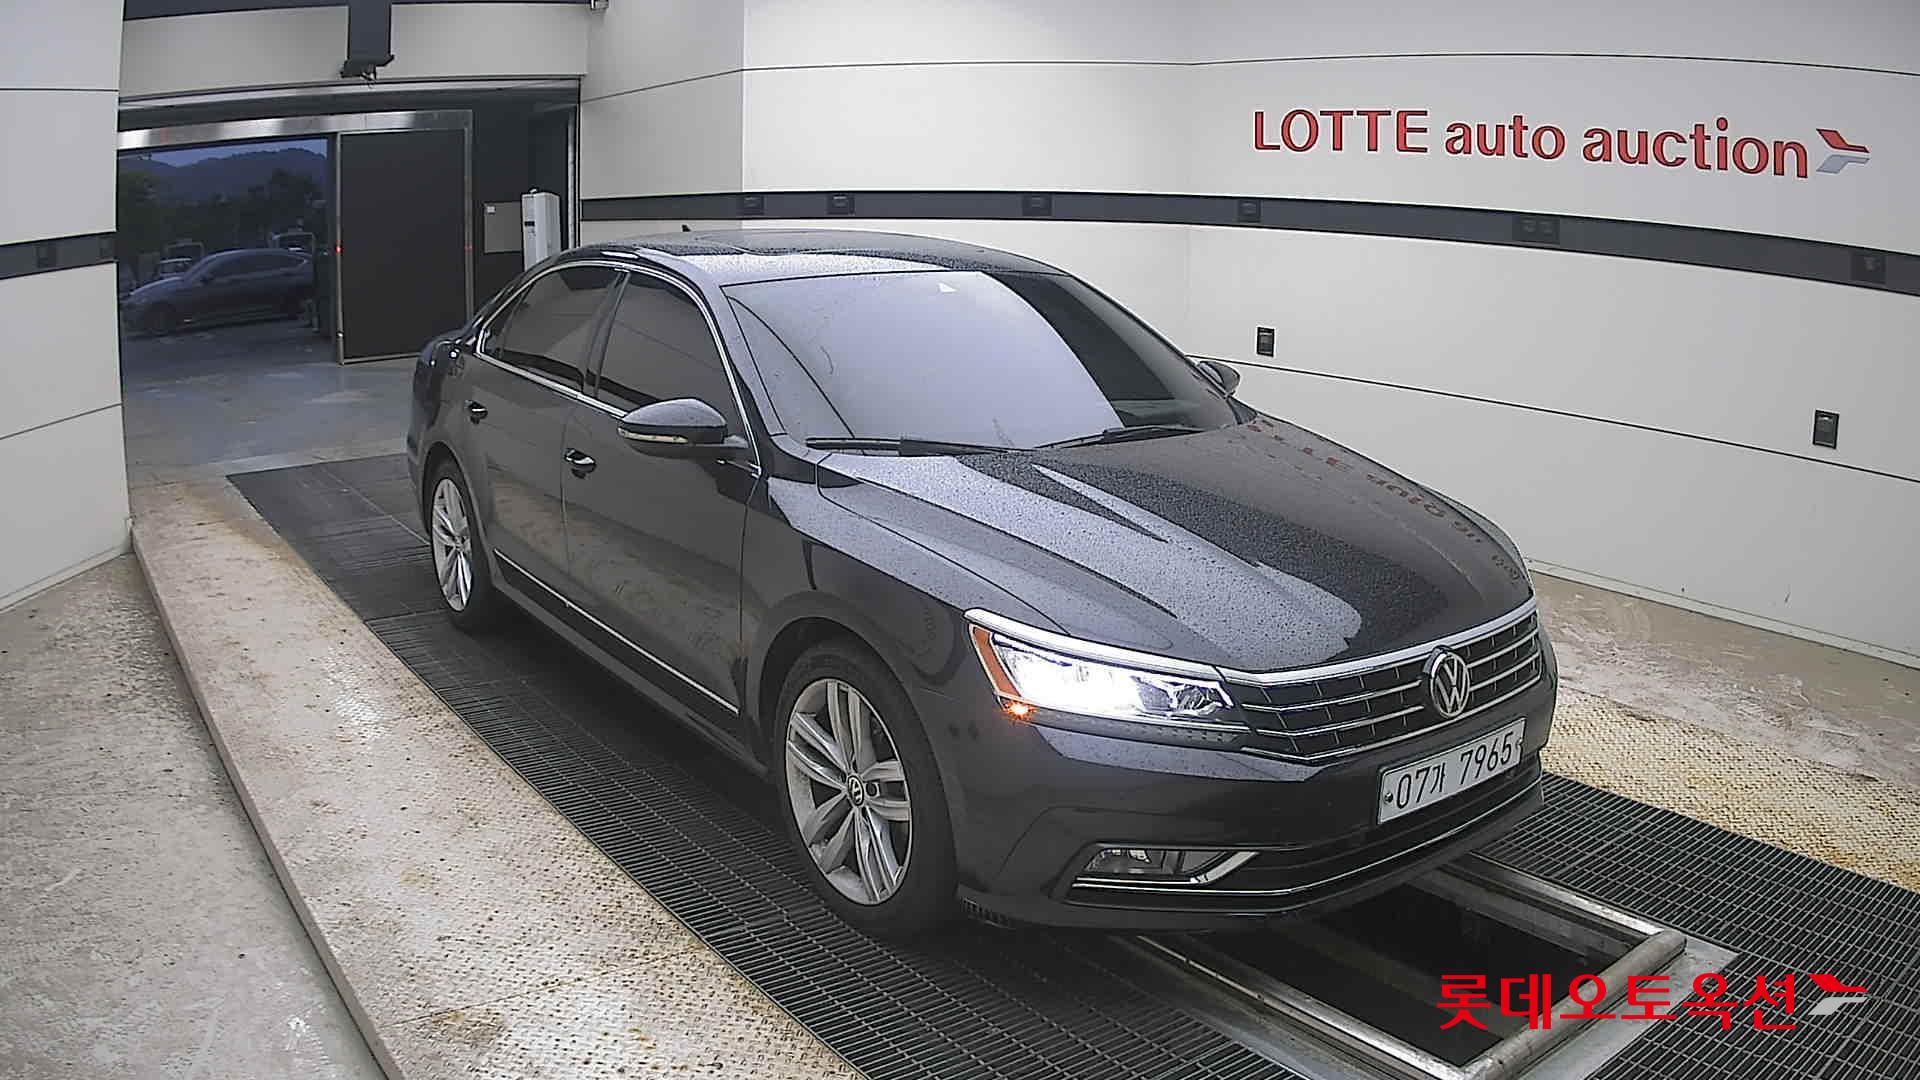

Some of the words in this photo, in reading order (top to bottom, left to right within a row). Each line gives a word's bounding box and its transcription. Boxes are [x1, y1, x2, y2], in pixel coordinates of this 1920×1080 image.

[1254, 109, 1429, 153] LOTTE
[1445, 115, 1566, 161] auto
[1583, 117, 1809, 179] auction
[1396, 762, 1446, 810] 07가
[1459, 731, 1515, 786] 7965
